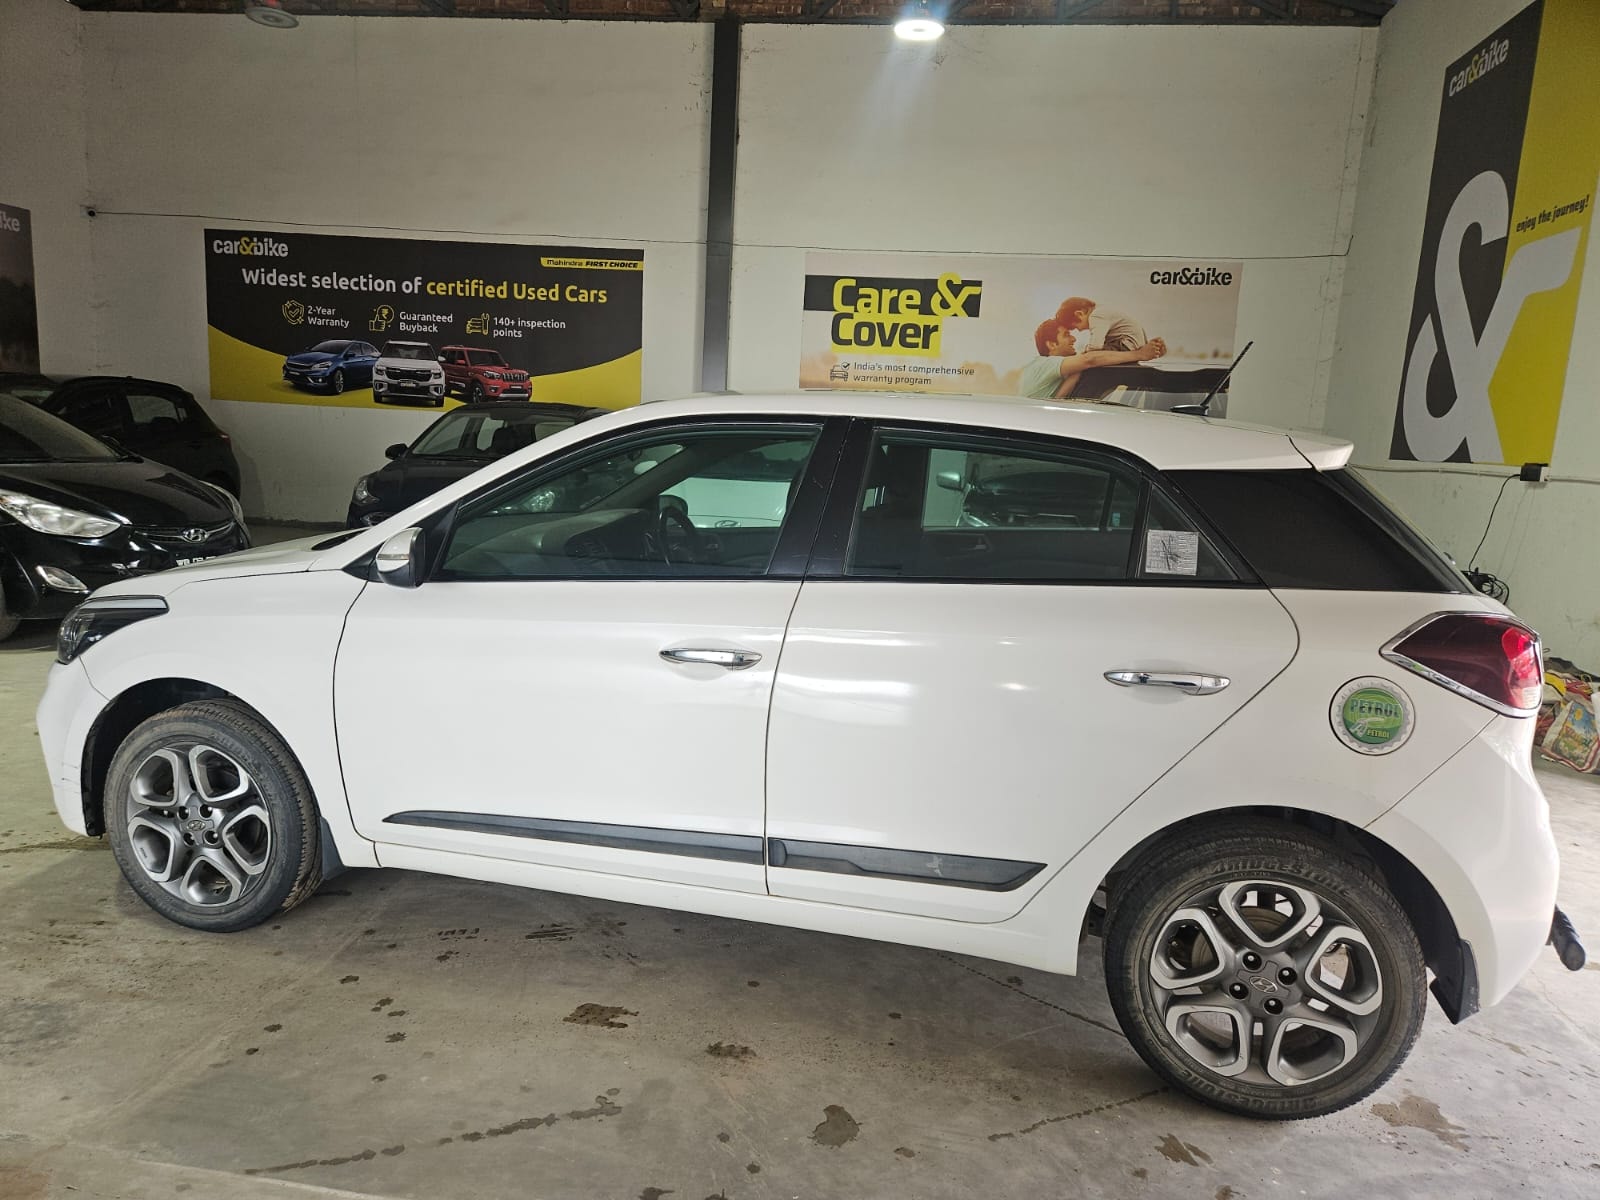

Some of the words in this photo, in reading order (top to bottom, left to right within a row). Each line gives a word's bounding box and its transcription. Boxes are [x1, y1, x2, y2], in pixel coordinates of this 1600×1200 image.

[1449, 38, 1510, 97] car&bike
[1516, 216, 1536, 232] enjoy
[1538, 210, 1551, 224] the
[1551, 194, 1590, 223] journey!
[213, 237, 288, 257] car&bike
[585, 260, 608, 268] FIRST
[609, 261, 638, 269] CHOICE
[1150, 268, 1232, 285] car&bike
[241, 268, 307, 288] Widest
[311, 272, 396, 293] selection
[402, 277, 422, 294] of
[426, 279, 508, 299] certified
[513, 283, 559, 302] Used
[565, 285, 608, 304] Cars
[832, 277, 922, 315] Care
[931, 272, 982, 318] &
[307, 305, 336, 316] 2-Year
[399, 311, 453, 323] Guaranteed
[307, 316, 350, 328] Warranty
[399, 322, 439, 333] Buyback
[493, 317, 515, 327] 140+
[518, 318, 566, 330] inspection
[493, 328, 523, 338] points
[831, 312, 939, 350] Cover
[854, 361, 882, 371] India's
[884, 364, 906, 372] most
[908, 365, 975, 376] comprehensive
[853, 374, 893, 384] warranty
[895, 376, 932, 386] program
[1350, 698, 1400, 718] PETROL
